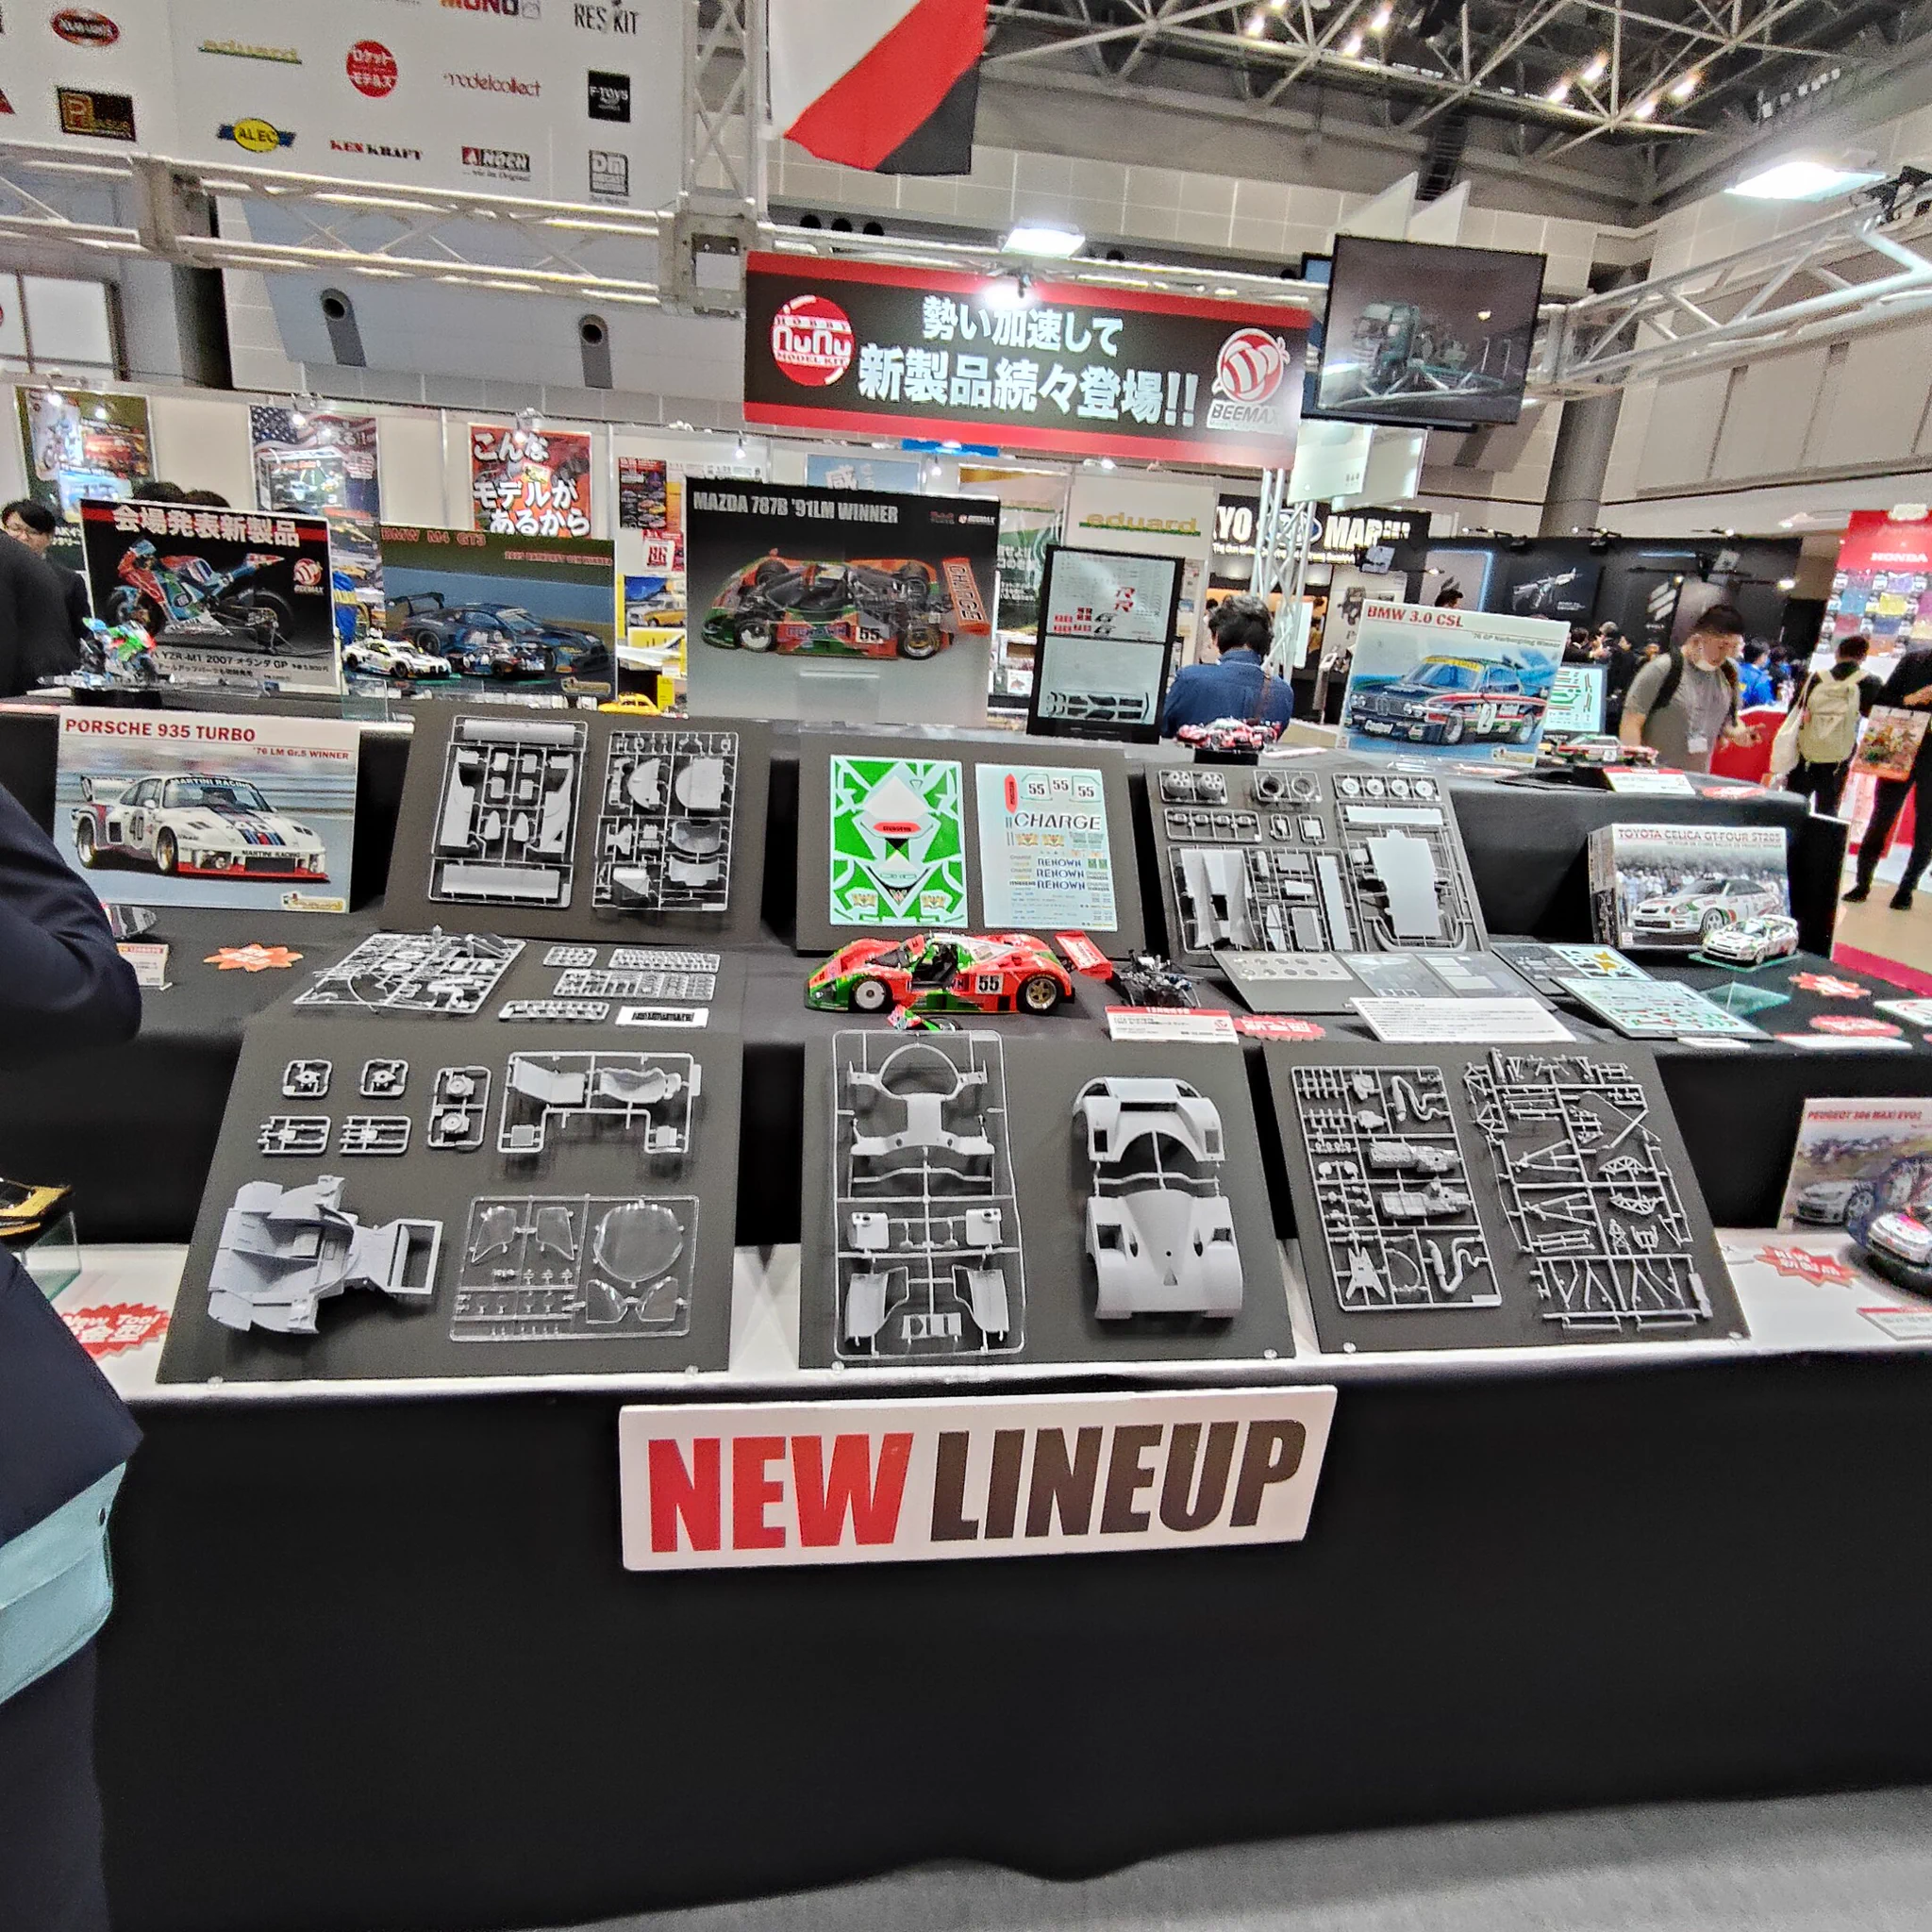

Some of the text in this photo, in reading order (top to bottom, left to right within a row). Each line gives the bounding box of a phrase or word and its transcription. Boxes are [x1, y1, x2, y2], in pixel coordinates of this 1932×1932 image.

[574, 3, 640, 34] RES KIT
[330, 140, 424, 161] KEN KRAFT
[923, 294, 1124, 358] 勢い加速して
[858, 341, 1200, 428] 新製品続々登場!!
[1211, 403, 1279, 425] BEEMAX
[473, 431, 550, 462] こんな
[472, 478, 579, 510] モデルが
[693, 491, 748, 513] MAZDA
[751, 495, 789, 517] 787B
[838, 502, 899, 524] WINNER
[112, 505, 300, 548] 会場発表新製品
[490, 508, 591, 537] あるから
[1087, 511, 1197, 535] eduard
[381, 527, 487, 546] BMW M4 GT3
[1871, 552, 1929, 563] HONDA
[1368, 606, 1464, 627] BMW 3.0 CSL
[859, 626, 880, 641] 55
[206, 655, 232, 664] 2007
[274, 659, 289, 669] GP
[66, 719, 256, 741] PORSCHE 935 TURBO
[309, 750, 350, 760] WINNER
[215, 779, 250, 789] RACING
[1028, 783, 1045, 795] 55
[1053, 779, 1069, 791] 55
[1078, 786, 1095, 798] 55
[1014, 812, 1101, 830] CHARGE
[1619, 829, 1662, 841] TOYOTA
[1664, 829, 1701, 841] CELICA
[1705, 831, 1748, 842] GT-FOUR
[1038, 858, 1081, 868] RENOWN
[1037, 868, 1084, 879] RENOWN
[1037, 879, 1085, 891] RENOWN
[978, 975, 1000, 991] 55
[648, 1419, 1307, 1553] NEW LINEUP
